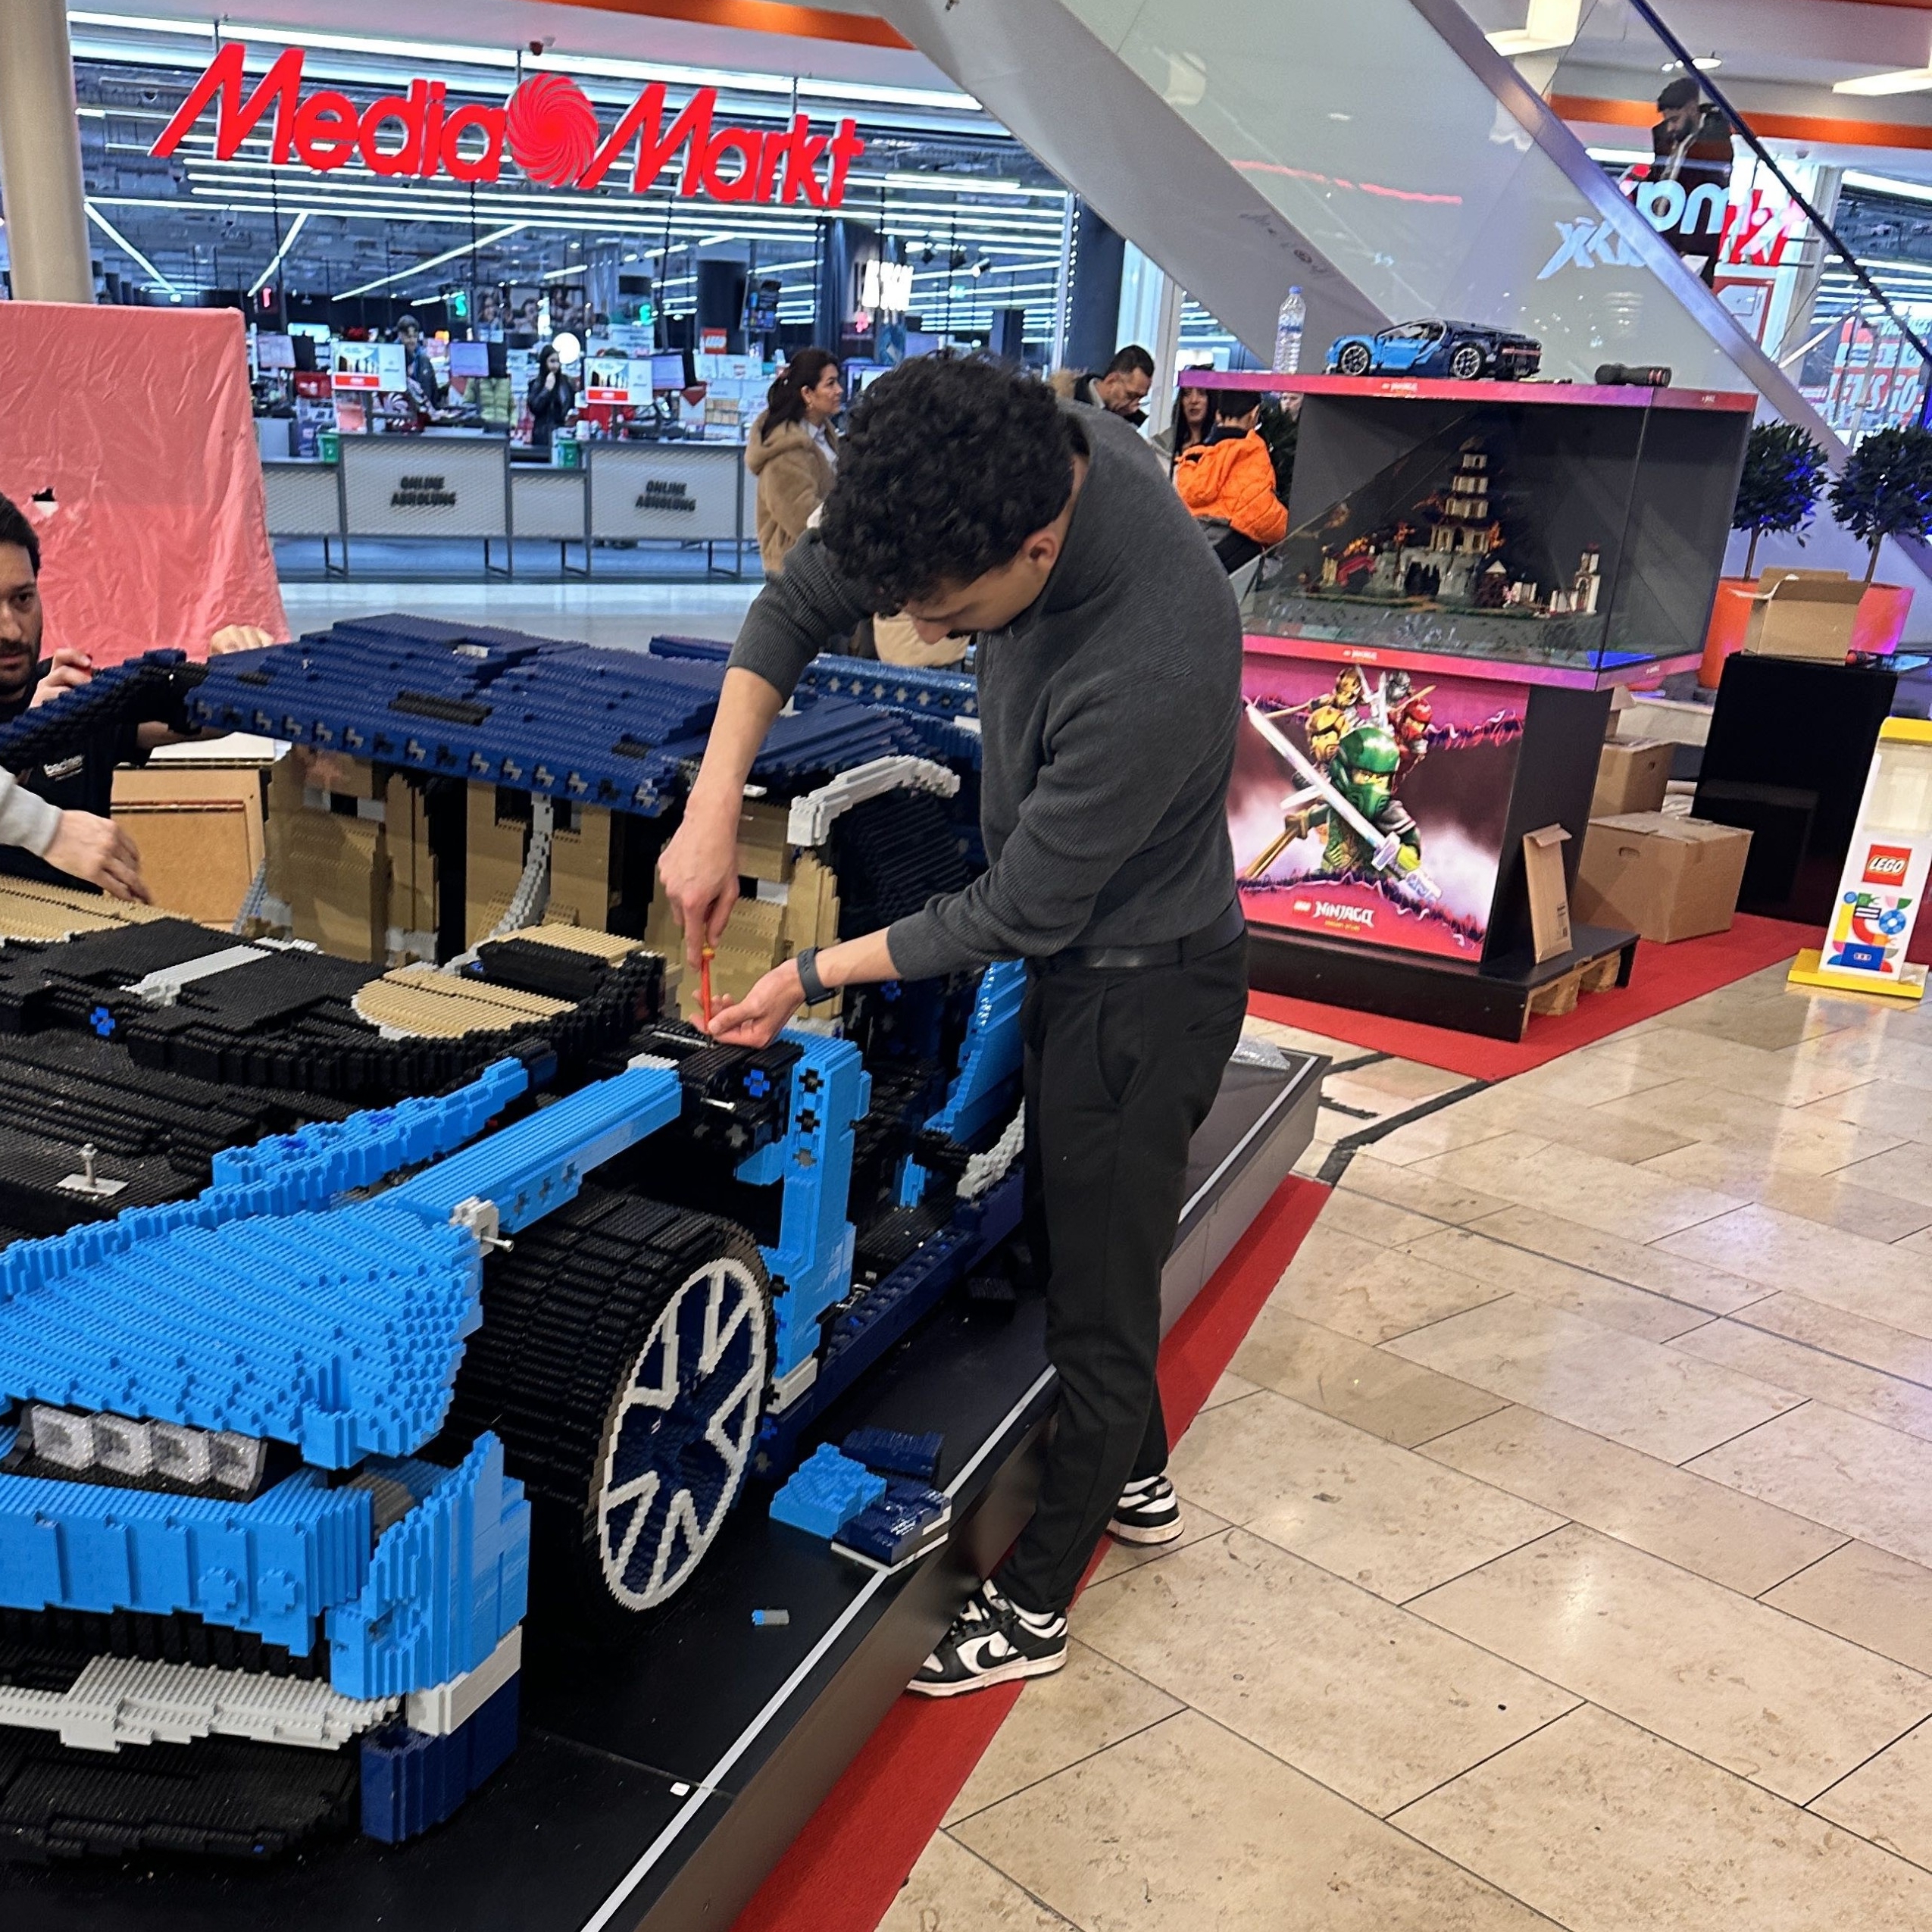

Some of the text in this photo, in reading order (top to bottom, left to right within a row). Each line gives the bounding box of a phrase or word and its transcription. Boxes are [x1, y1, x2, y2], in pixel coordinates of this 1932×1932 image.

[149, 42, 864, 208] Media Markt
[646, 480, 687, 496] ONLINE
[1868, 857, 1906, 874] LEGO
[1312, 900, 1374, 928] NINJAGO
